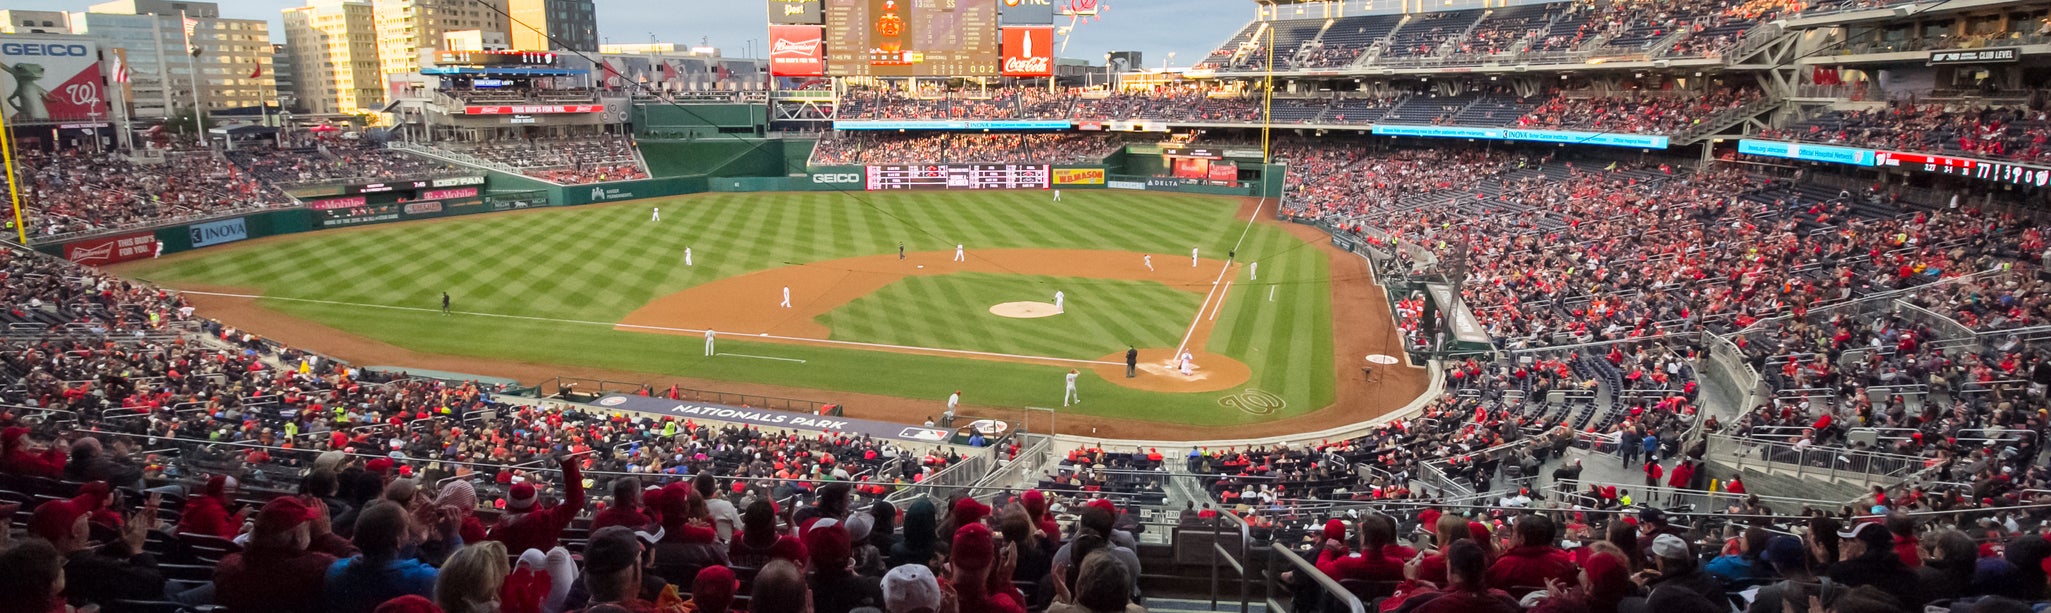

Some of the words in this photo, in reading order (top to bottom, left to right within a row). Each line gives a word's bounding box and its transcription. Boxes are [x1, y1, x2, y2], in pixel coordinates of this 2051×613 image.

[2, 43, 87, 57] GEICO
[1979, 51, 1994, 60] CLUB
[1995, 50, 2013, 59] LEVEL
[1508, 131, 1528, 140] INOVA
[812, 173, 860, 184] GEICO
[1977, 163, 1991, 179] 77
[2025, 171, 2033, 183] 0
[205, 223, 245, 241] INOVA
[117, 239, 134, 248] THIS
[134, 235, 155, 245] BUD'S
[119, 247, 134, 256] FOR
[671, 404, 788, 424] NATIONALS
[790, 416, 848, 430] PARK
